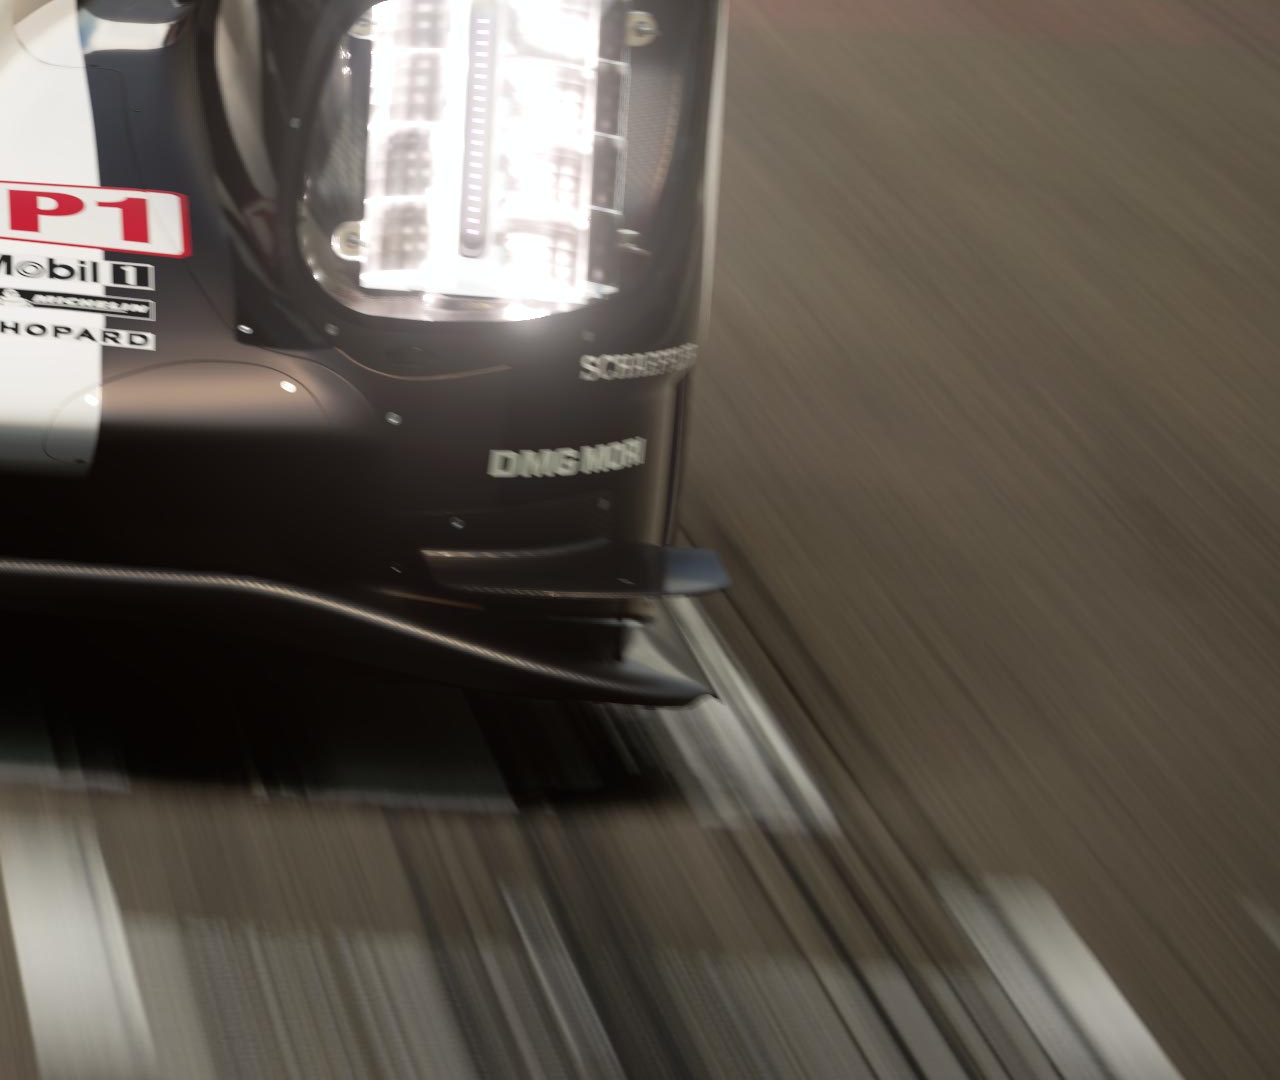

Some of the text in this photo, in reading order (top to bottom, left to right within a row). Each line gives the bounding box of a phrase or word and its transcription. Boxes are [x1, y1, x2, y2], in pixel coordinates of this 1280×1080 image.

[8, 189, 152, 244] P1
[31, 294, 150, 315] MICHELIN
[487, 446, 580, 478] DMG
